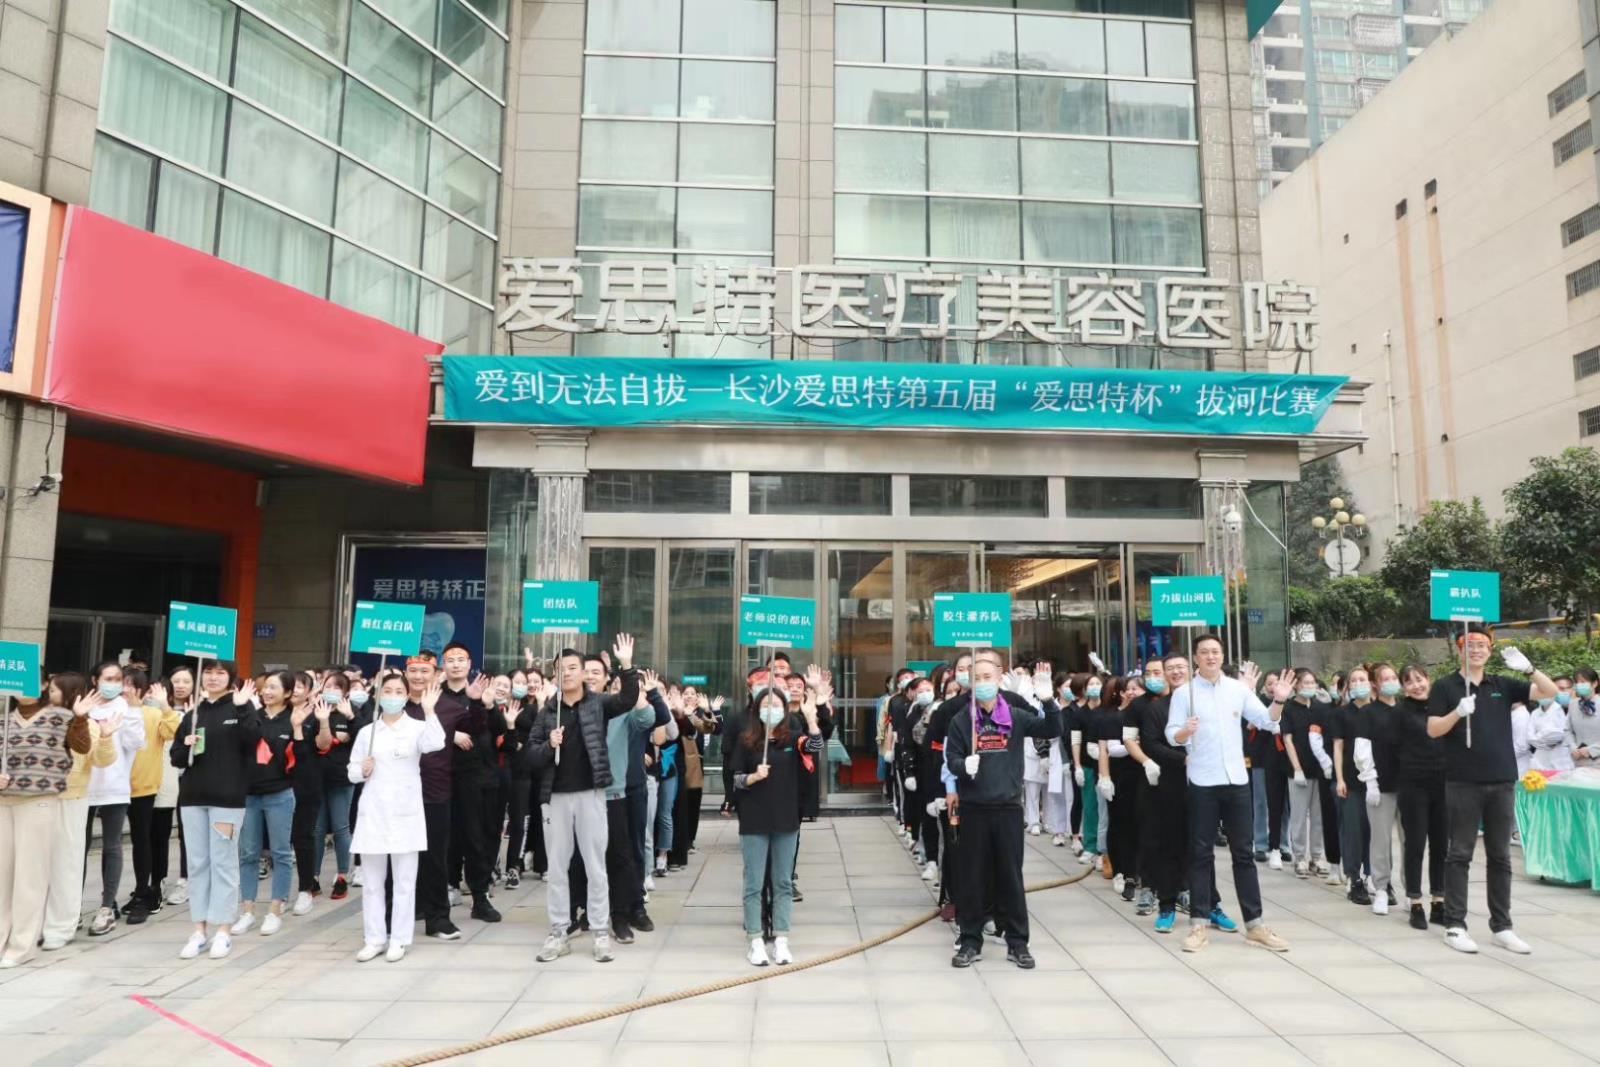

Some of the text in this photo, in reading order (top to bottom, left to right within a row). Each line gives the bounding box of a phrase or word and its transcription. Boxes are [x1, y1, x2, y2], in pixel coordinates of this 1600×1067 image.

[497, 257, 1320, 351] 爱思特医疗美容医院
[373, 578, 485, 600] 爱思特矫正
[543, 597, 577, 609] 团结队
[1160, 592, 1216, 603] 力拔山河队
[744, 611, 811, 626] 老师说的都队
